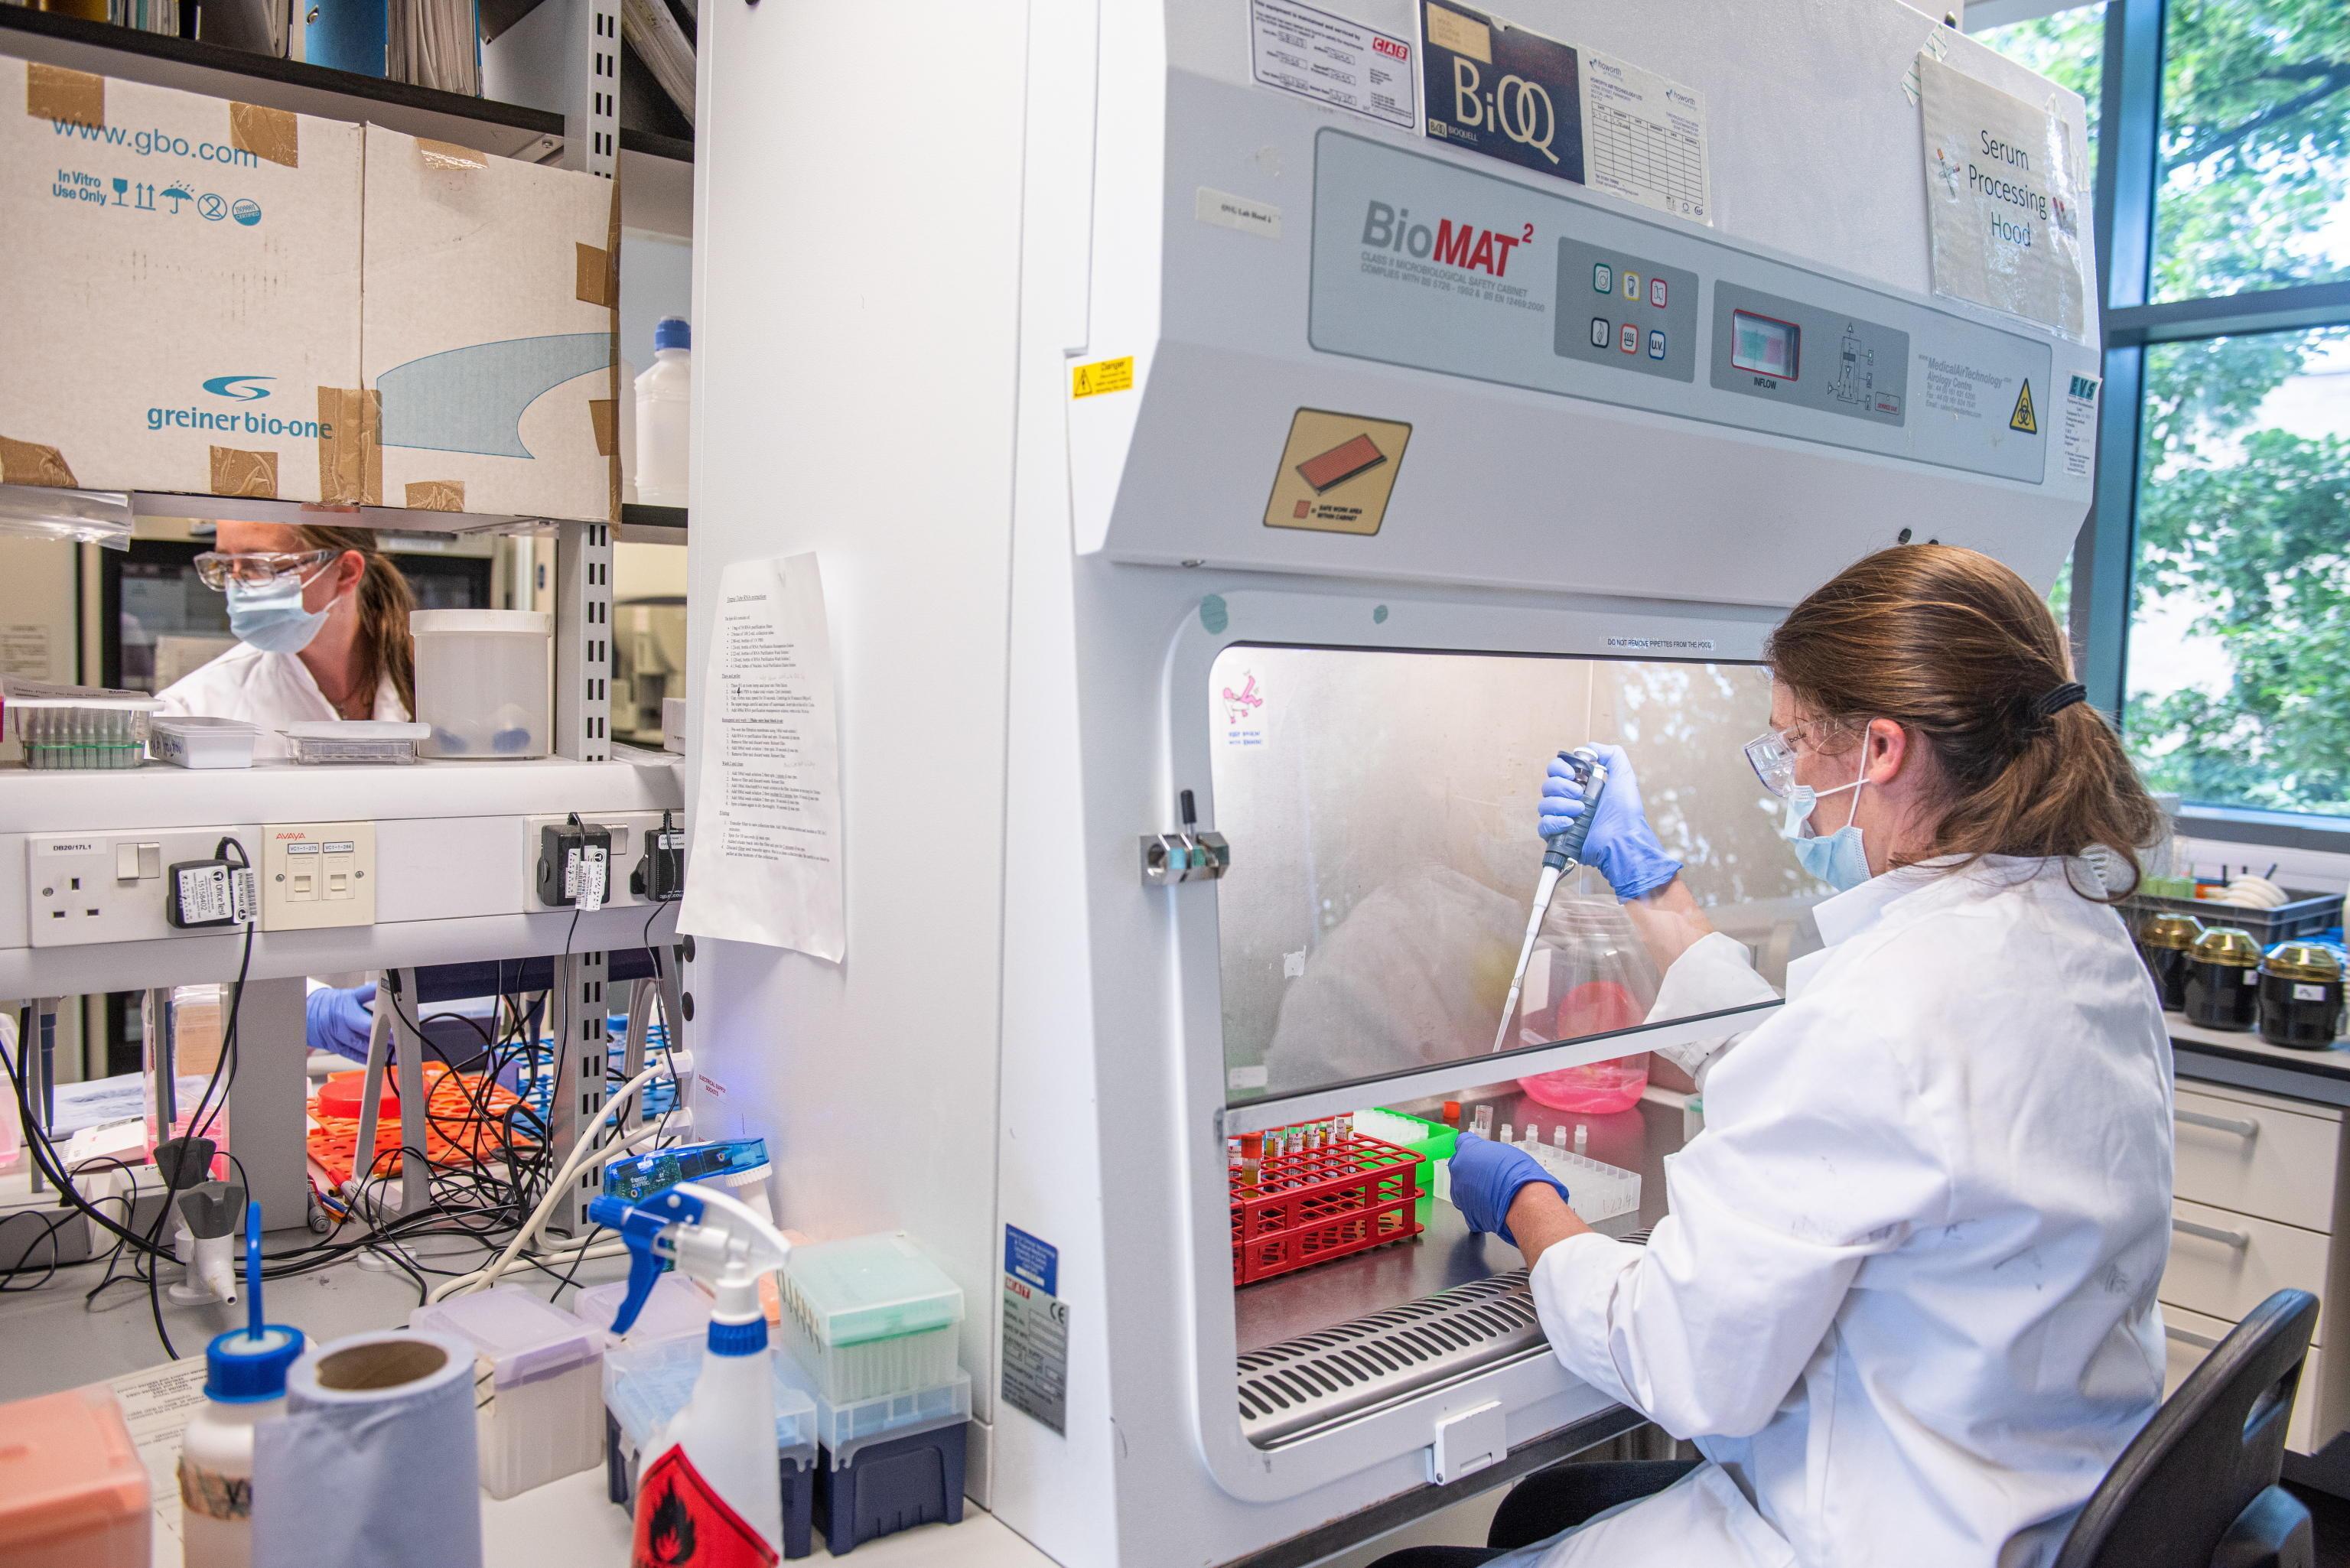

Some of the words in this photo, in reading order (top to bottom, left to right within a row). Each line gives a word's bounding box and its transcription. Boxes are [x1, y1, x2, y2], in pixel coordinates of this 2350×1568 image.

[1374, 37, 1407, 59] CAS
[1598, 60, 1622, 76] howorth
[1674, 91, 1695, 106] howorth
[53, 116, 258, 168] www.gbo.com
[1447, 125, 1478, 142] BIOQUELL
[1981, 129, 2029, 171] Serum
[58, 169, 70, 184] In
[72, 171, 101, 187] Vitro
[53, 184, 76, 199] Use
[79, 186, 107, 206] Only
[1968, 164, 2047, 220] Processing
[1991, 211, 2031, 248] Hood
[1361, 251, 1388, 265] CLASS
[1395, 259, 1466, 284] MICROBIOLOGICAL
[1468, 275, 1496, 289] SAFETY
[1497, 282, 1528, 298] CABINET
[1361, 262, 1399, 280] COMPLIES
[1401, 273, 1420, 285] WITH
[1494, 294, 1504, 304] EN
[1652, 340, 1663, 351] U.V.
[1101, 361, 1125, 371] Danger
[1754, 377, 1776, 390] INFLOW
[1928, 371, 1951, 387] Airology
[1953, 378, 1972, 391] Centre
[147, 407, 240, 431] greiner
[245, 412, 334, 440] bio-one
[198, 880, 207, 910] 15158402
[699, 1074, 714, 1088] ELECTRICAL
[716, 1083, 726, 1094] SUPPLY
[706, 1085, 718, 1097] SOCKETS
